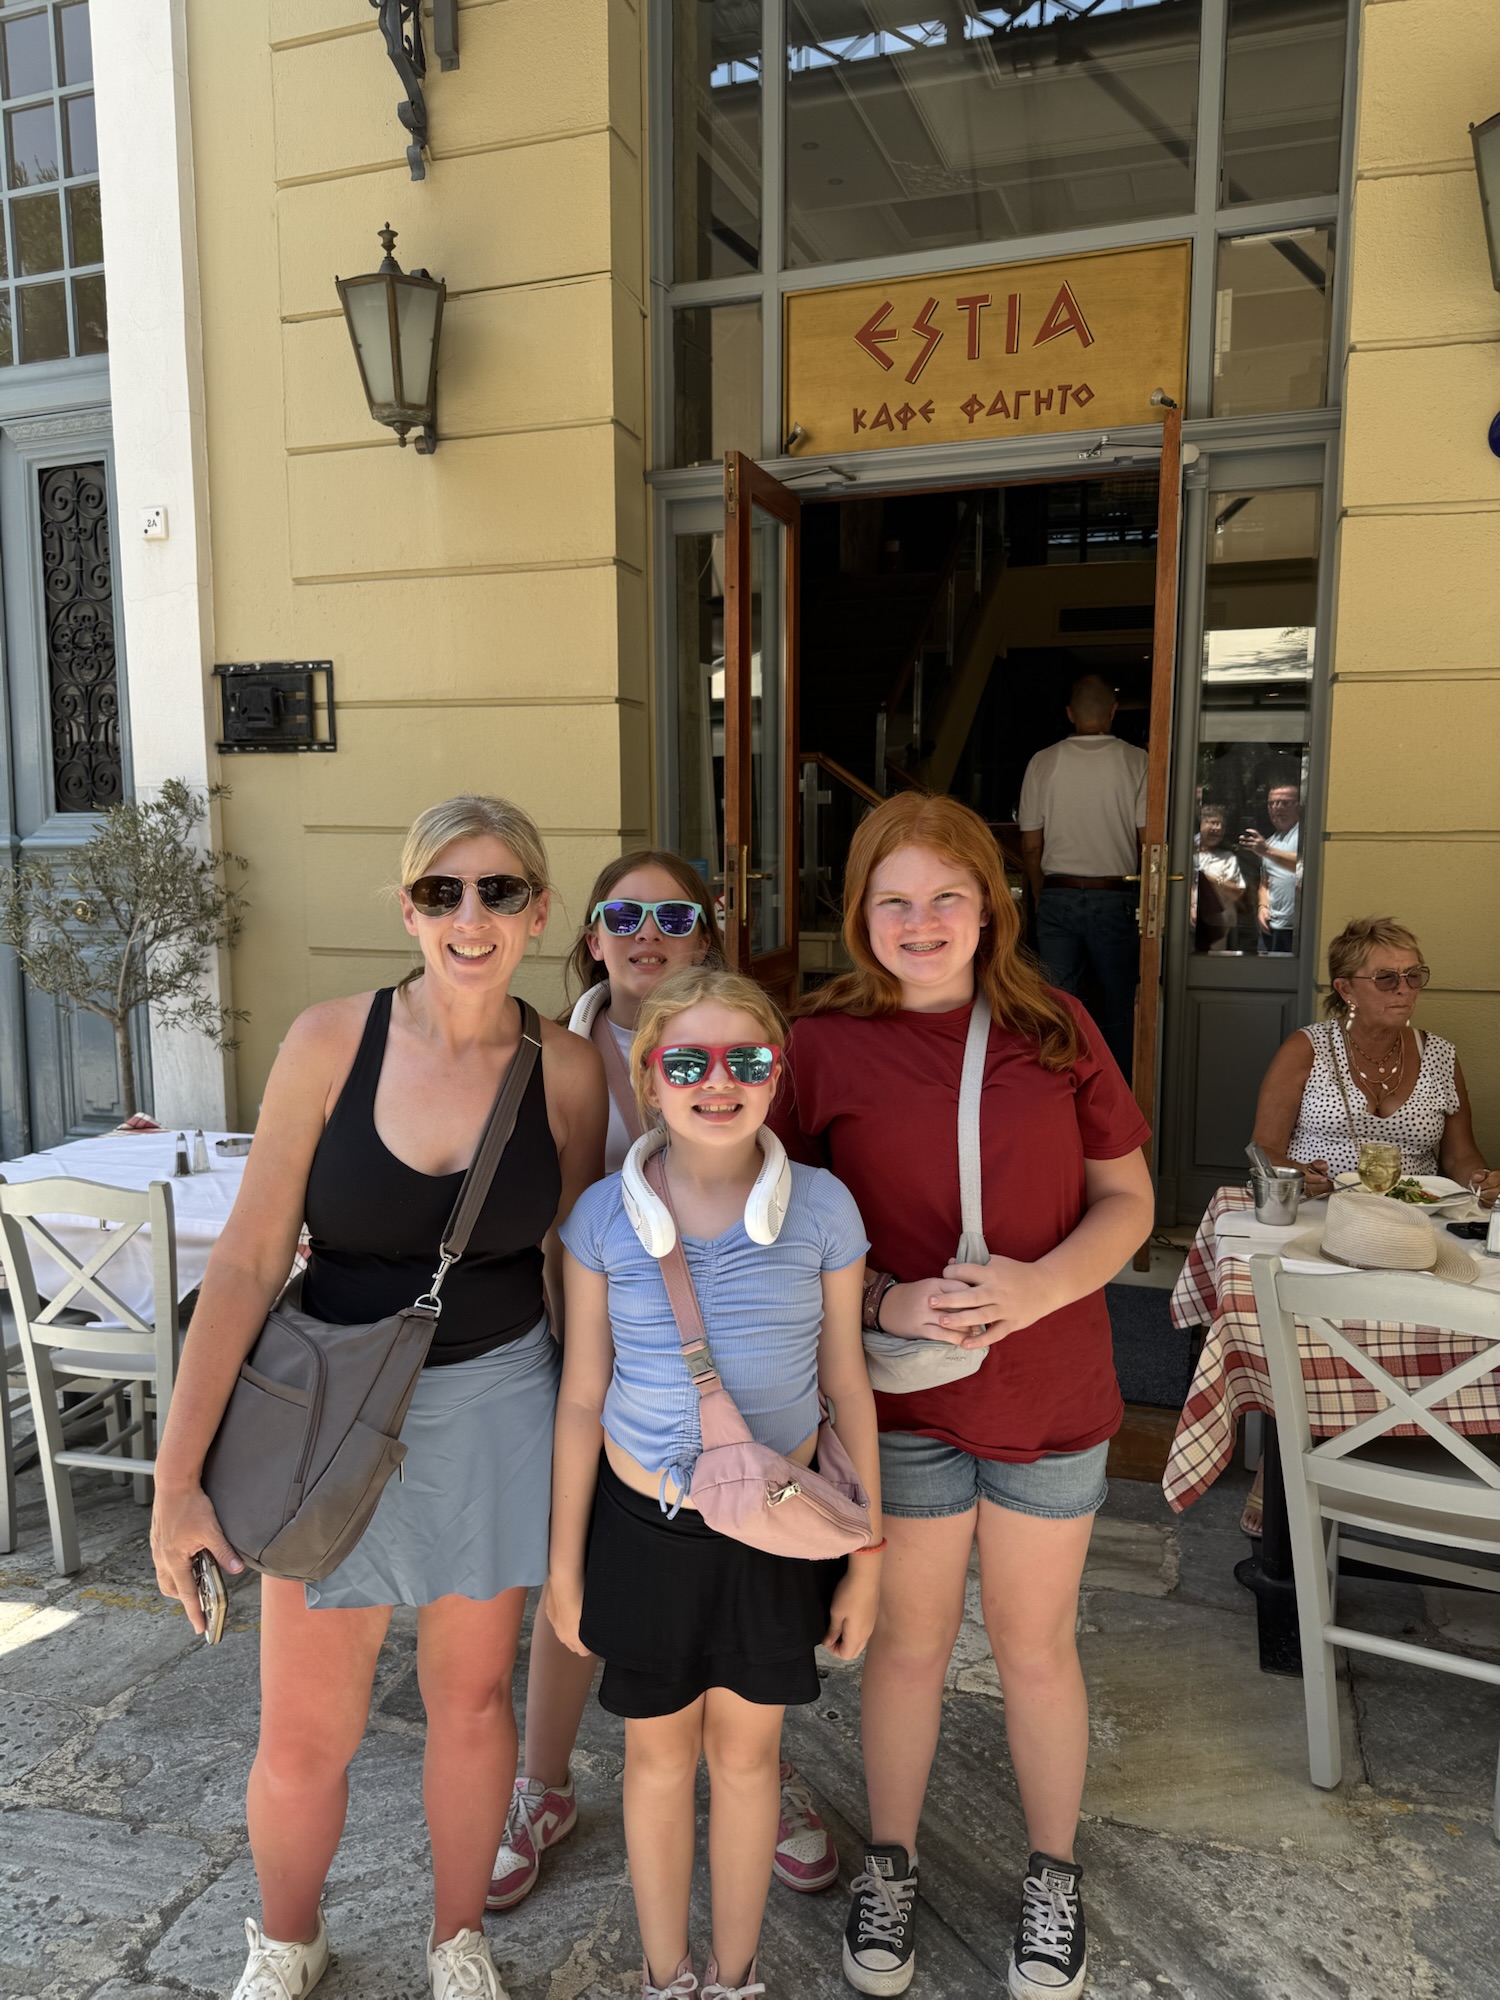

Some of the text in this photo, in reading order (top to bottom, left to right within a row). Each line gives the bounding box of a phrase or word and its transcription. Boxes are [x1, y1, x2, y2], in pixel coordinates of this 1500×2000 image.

[853, 280, 1095, 384] ESTIA
[852, 383, 1095, 434] ΚΑΦΕ ΦΑΓΗΤΟ
[147, 519, 158, 528] 2A
